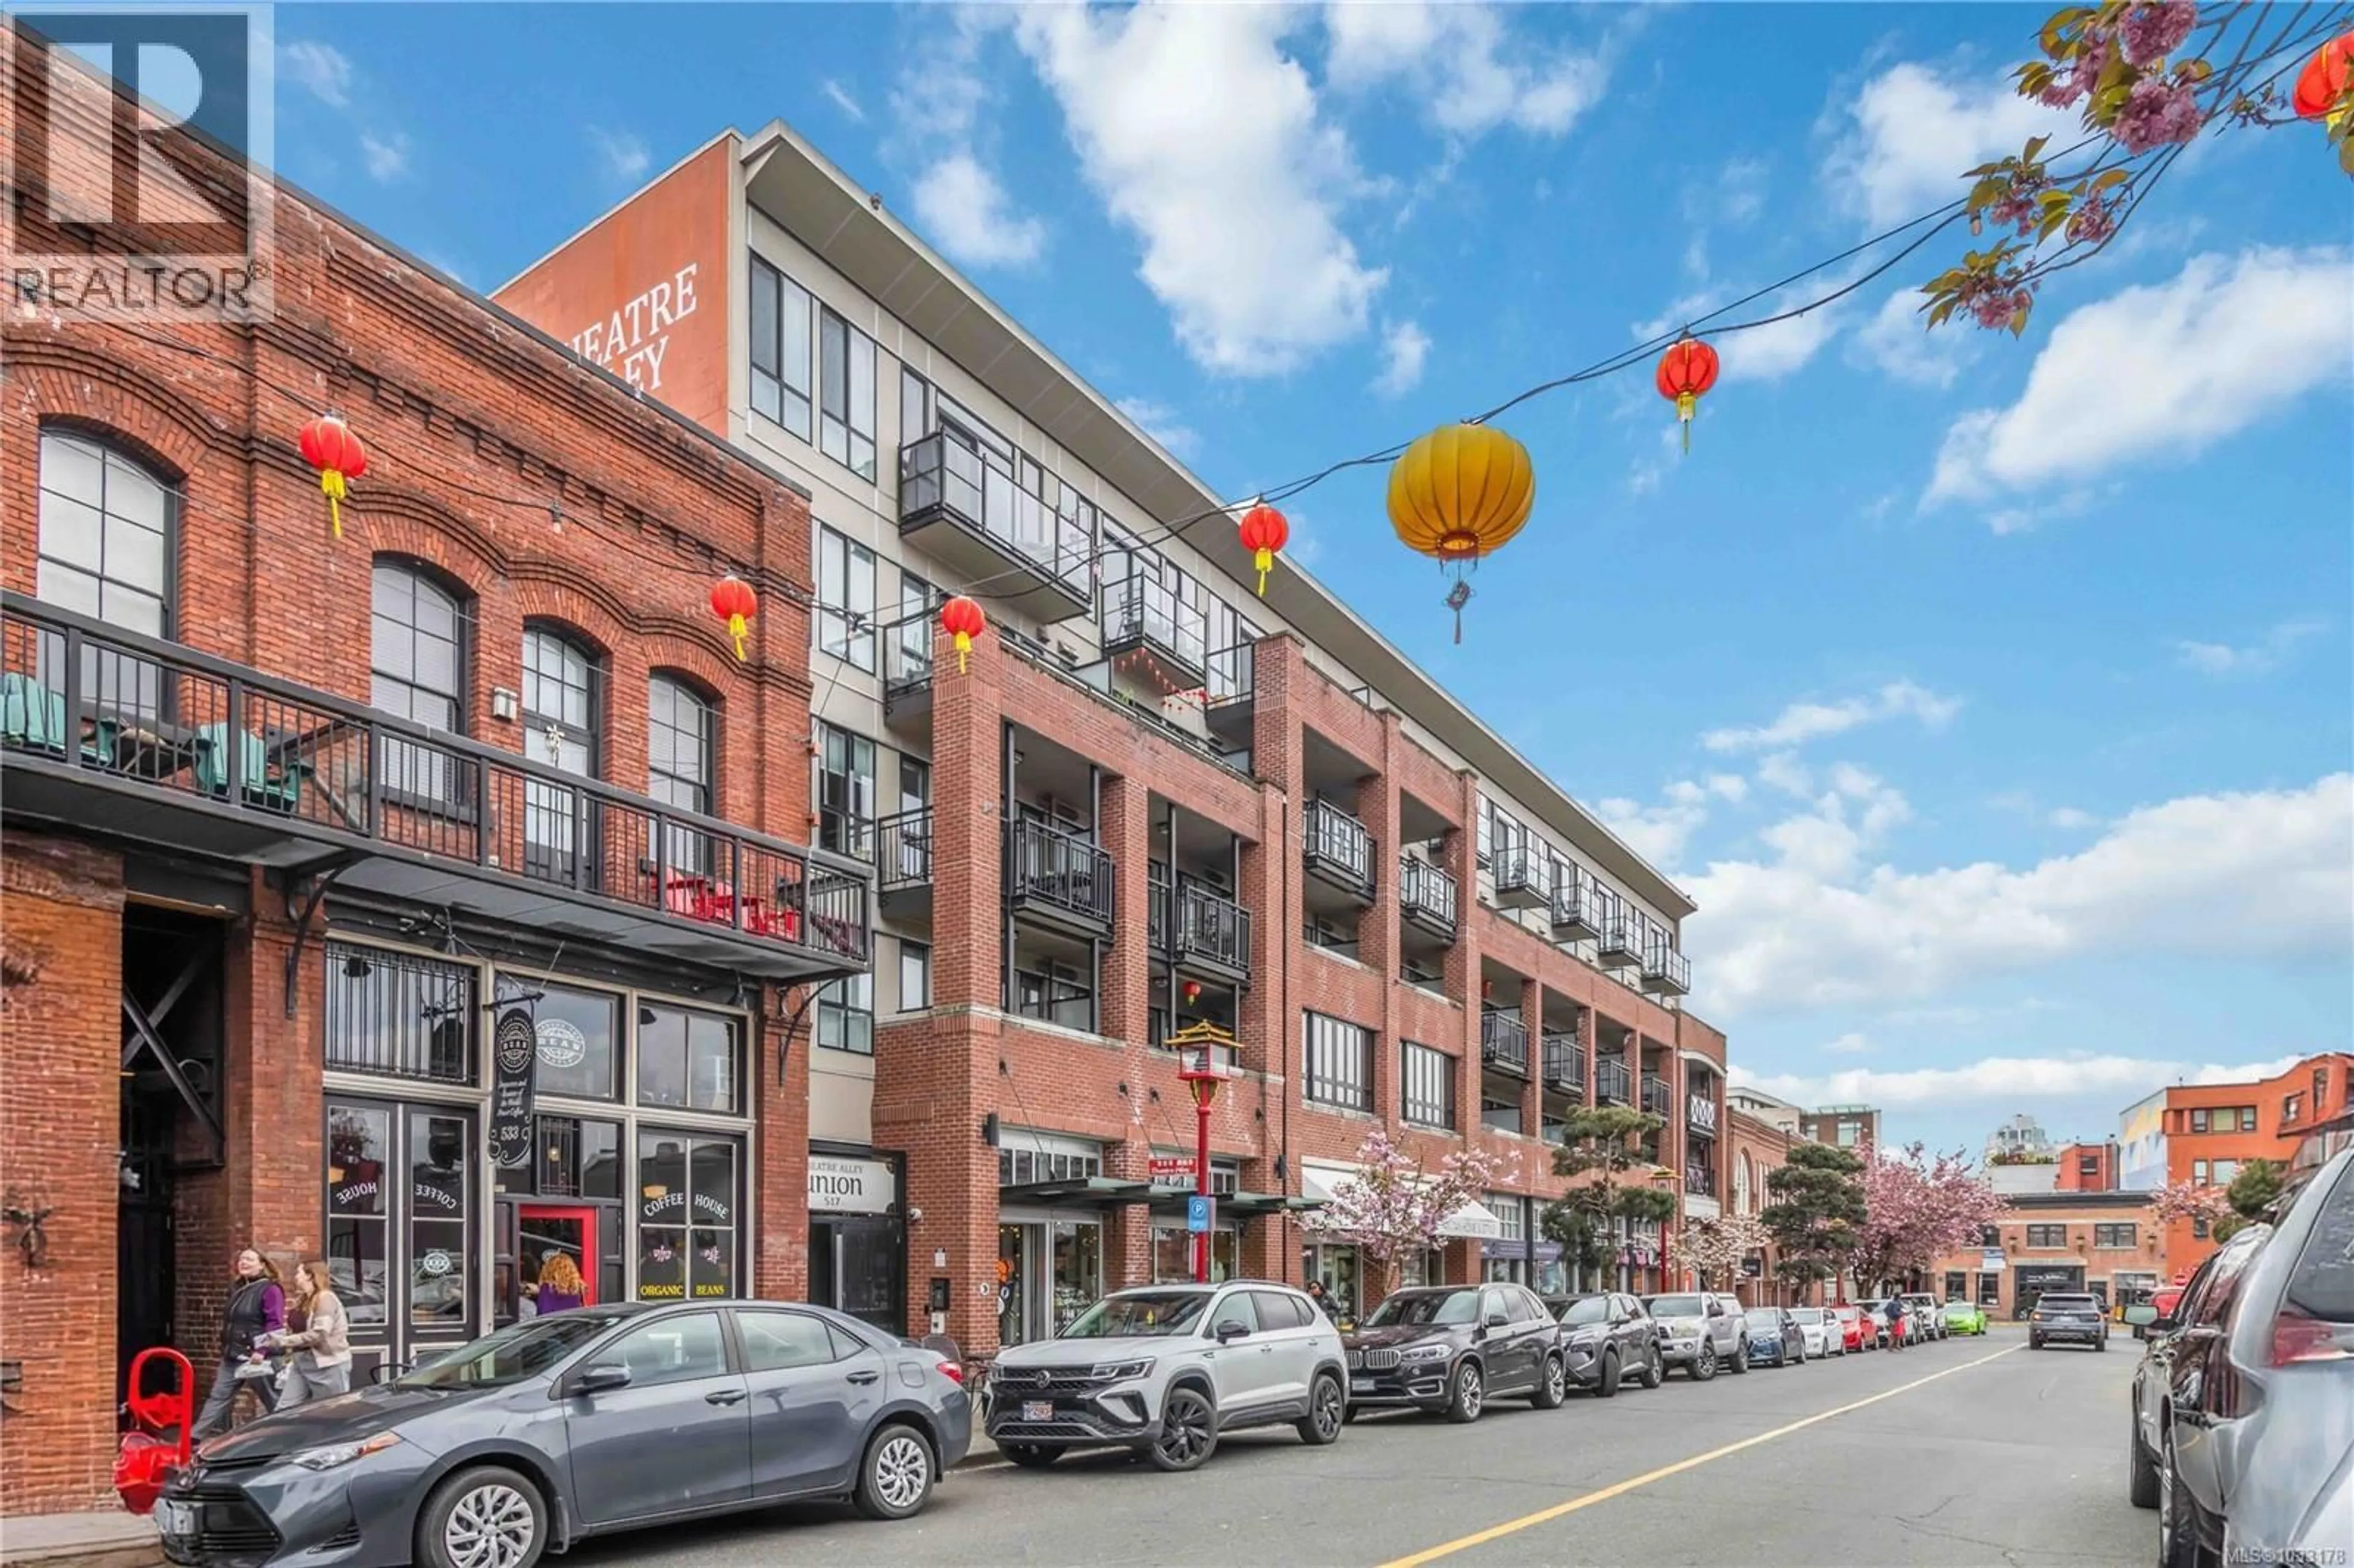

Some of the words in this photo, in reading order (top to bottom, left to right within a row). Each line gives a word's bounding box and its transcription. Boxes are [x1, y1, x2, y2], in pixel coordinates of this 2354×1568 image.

[608, 335, 669, 392] EY
[644, 1192, 685, 1217] COFFEE
[694, 1193, 729, 1219] HOUSE
[640, 1284, 684, 1296] ORGANIC
[695, 1284, 725, 1295] BEANS
